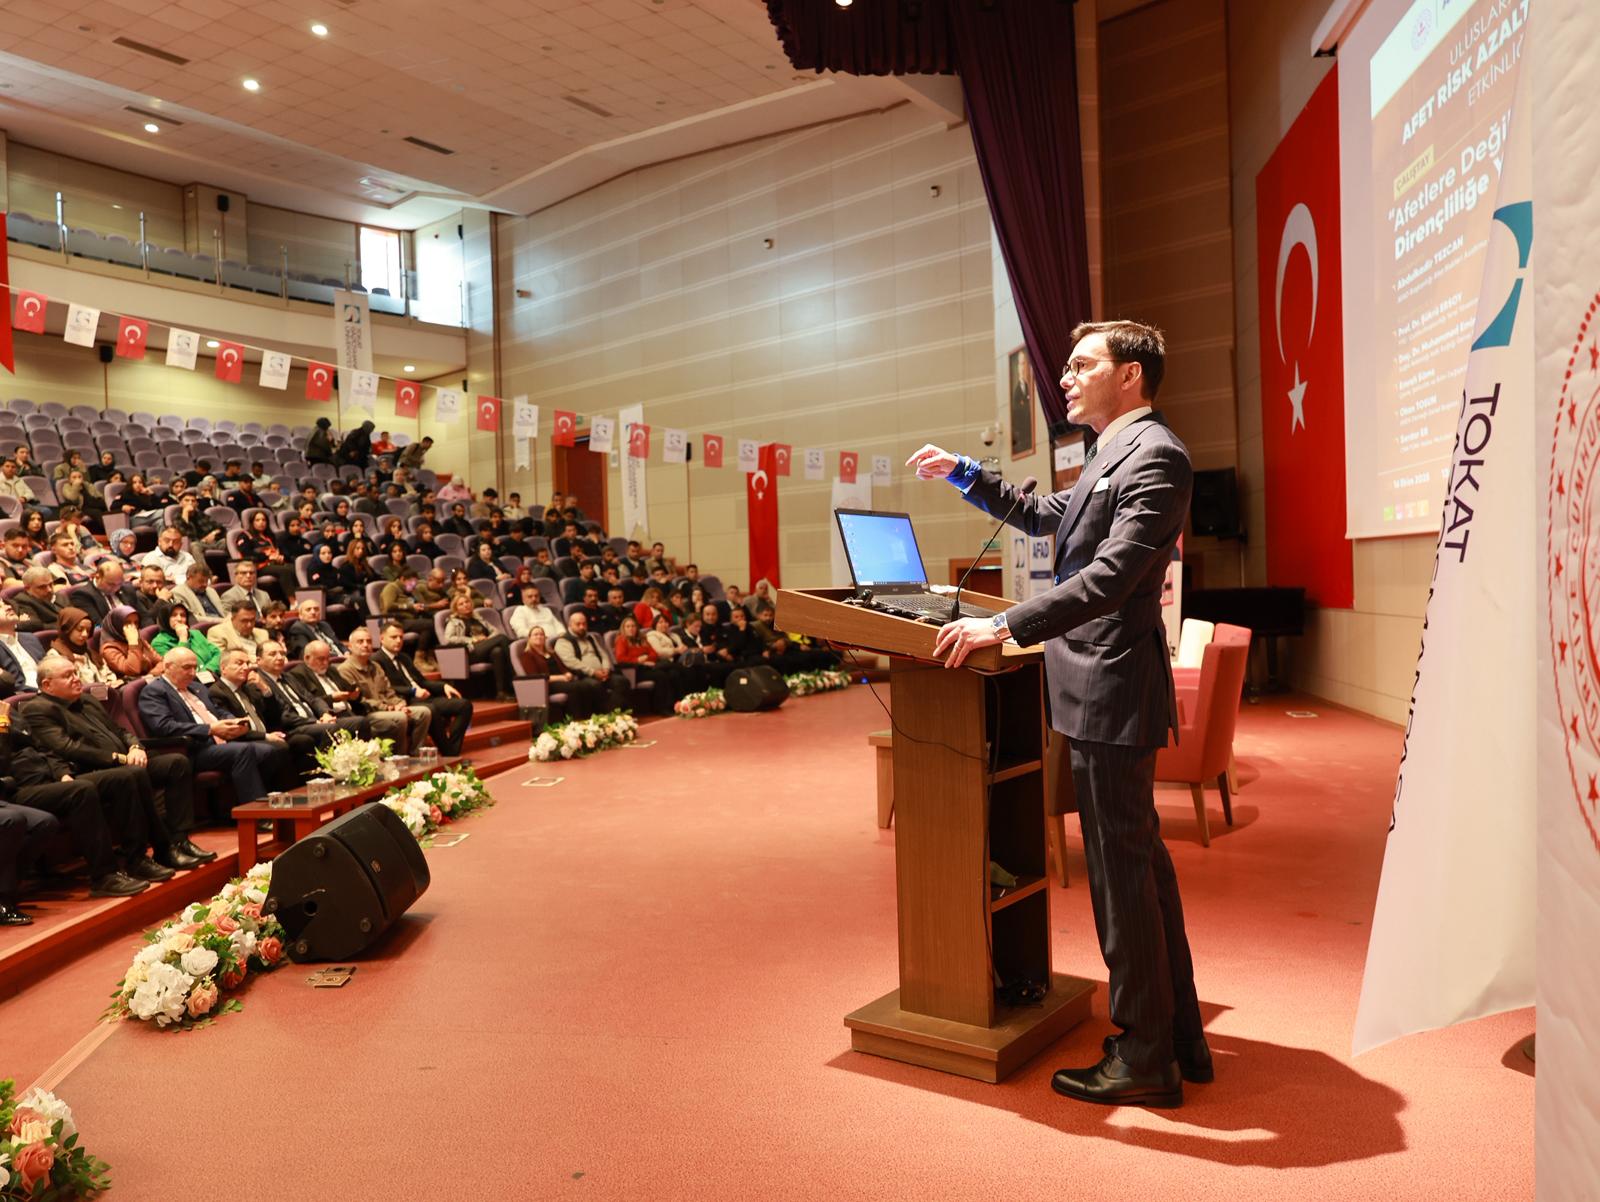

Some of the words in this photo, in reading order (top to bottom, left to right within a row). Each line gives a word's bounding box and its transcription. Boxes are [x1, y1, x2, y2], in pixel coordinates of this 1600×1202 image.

[1449, 0, 1511, 66] ULUSLAR
[1402, 95, 1435, 145] AFET
[1437, 55, 1473, 110] RİSK
[1395, 173, 1489, 261] Dirençliliğe
[1444, 382, 1502, 564] TOKAT
